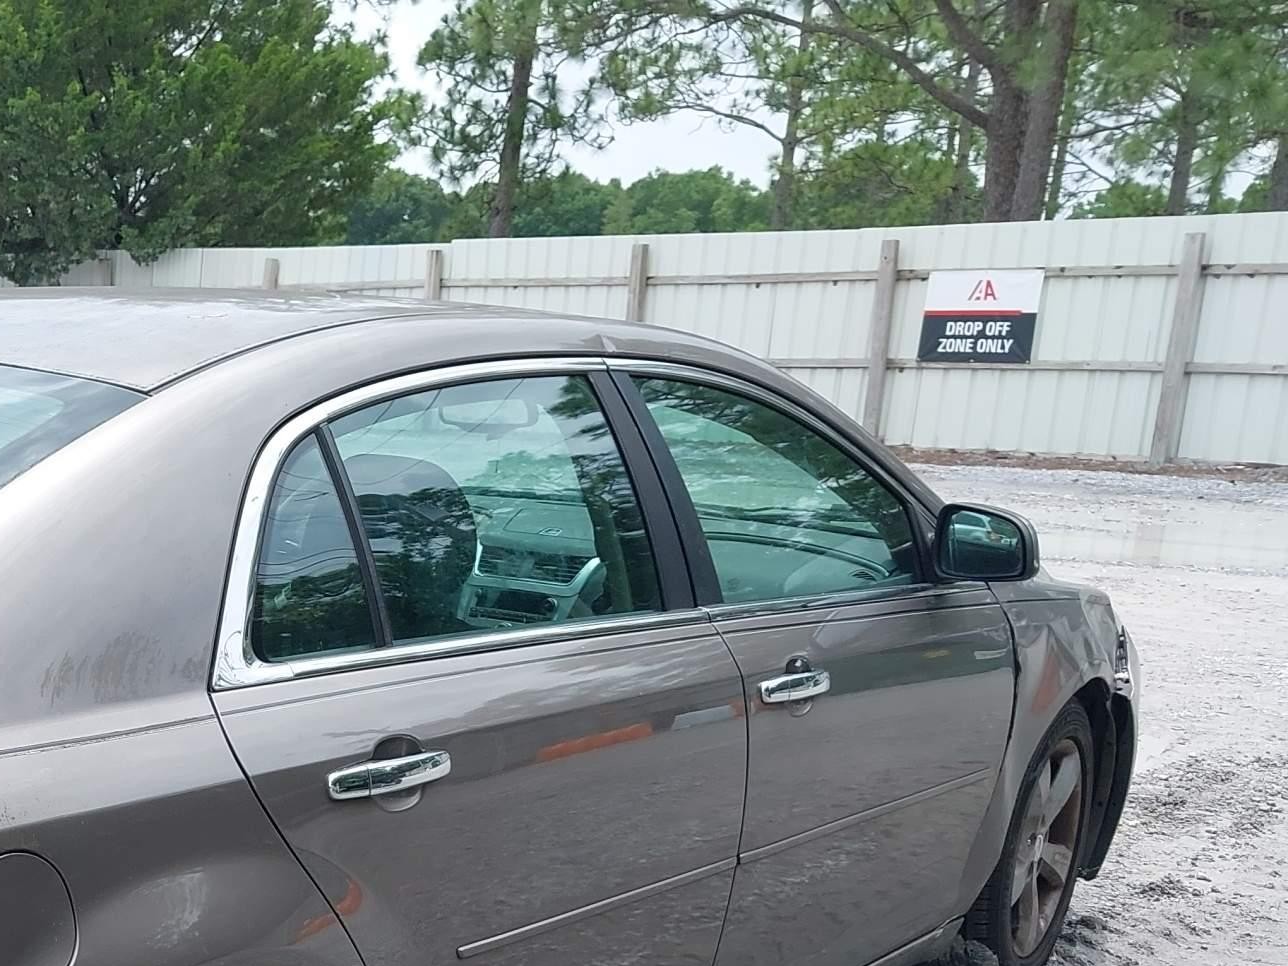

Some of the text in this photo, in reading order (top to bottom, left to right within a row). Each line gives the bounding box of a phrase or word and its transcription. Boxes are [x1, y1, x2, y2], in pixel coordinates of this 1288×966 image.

[945, 321, 1011, 336] DROP OFF
[936, 338, 1014, 354] ZONE ONLY
